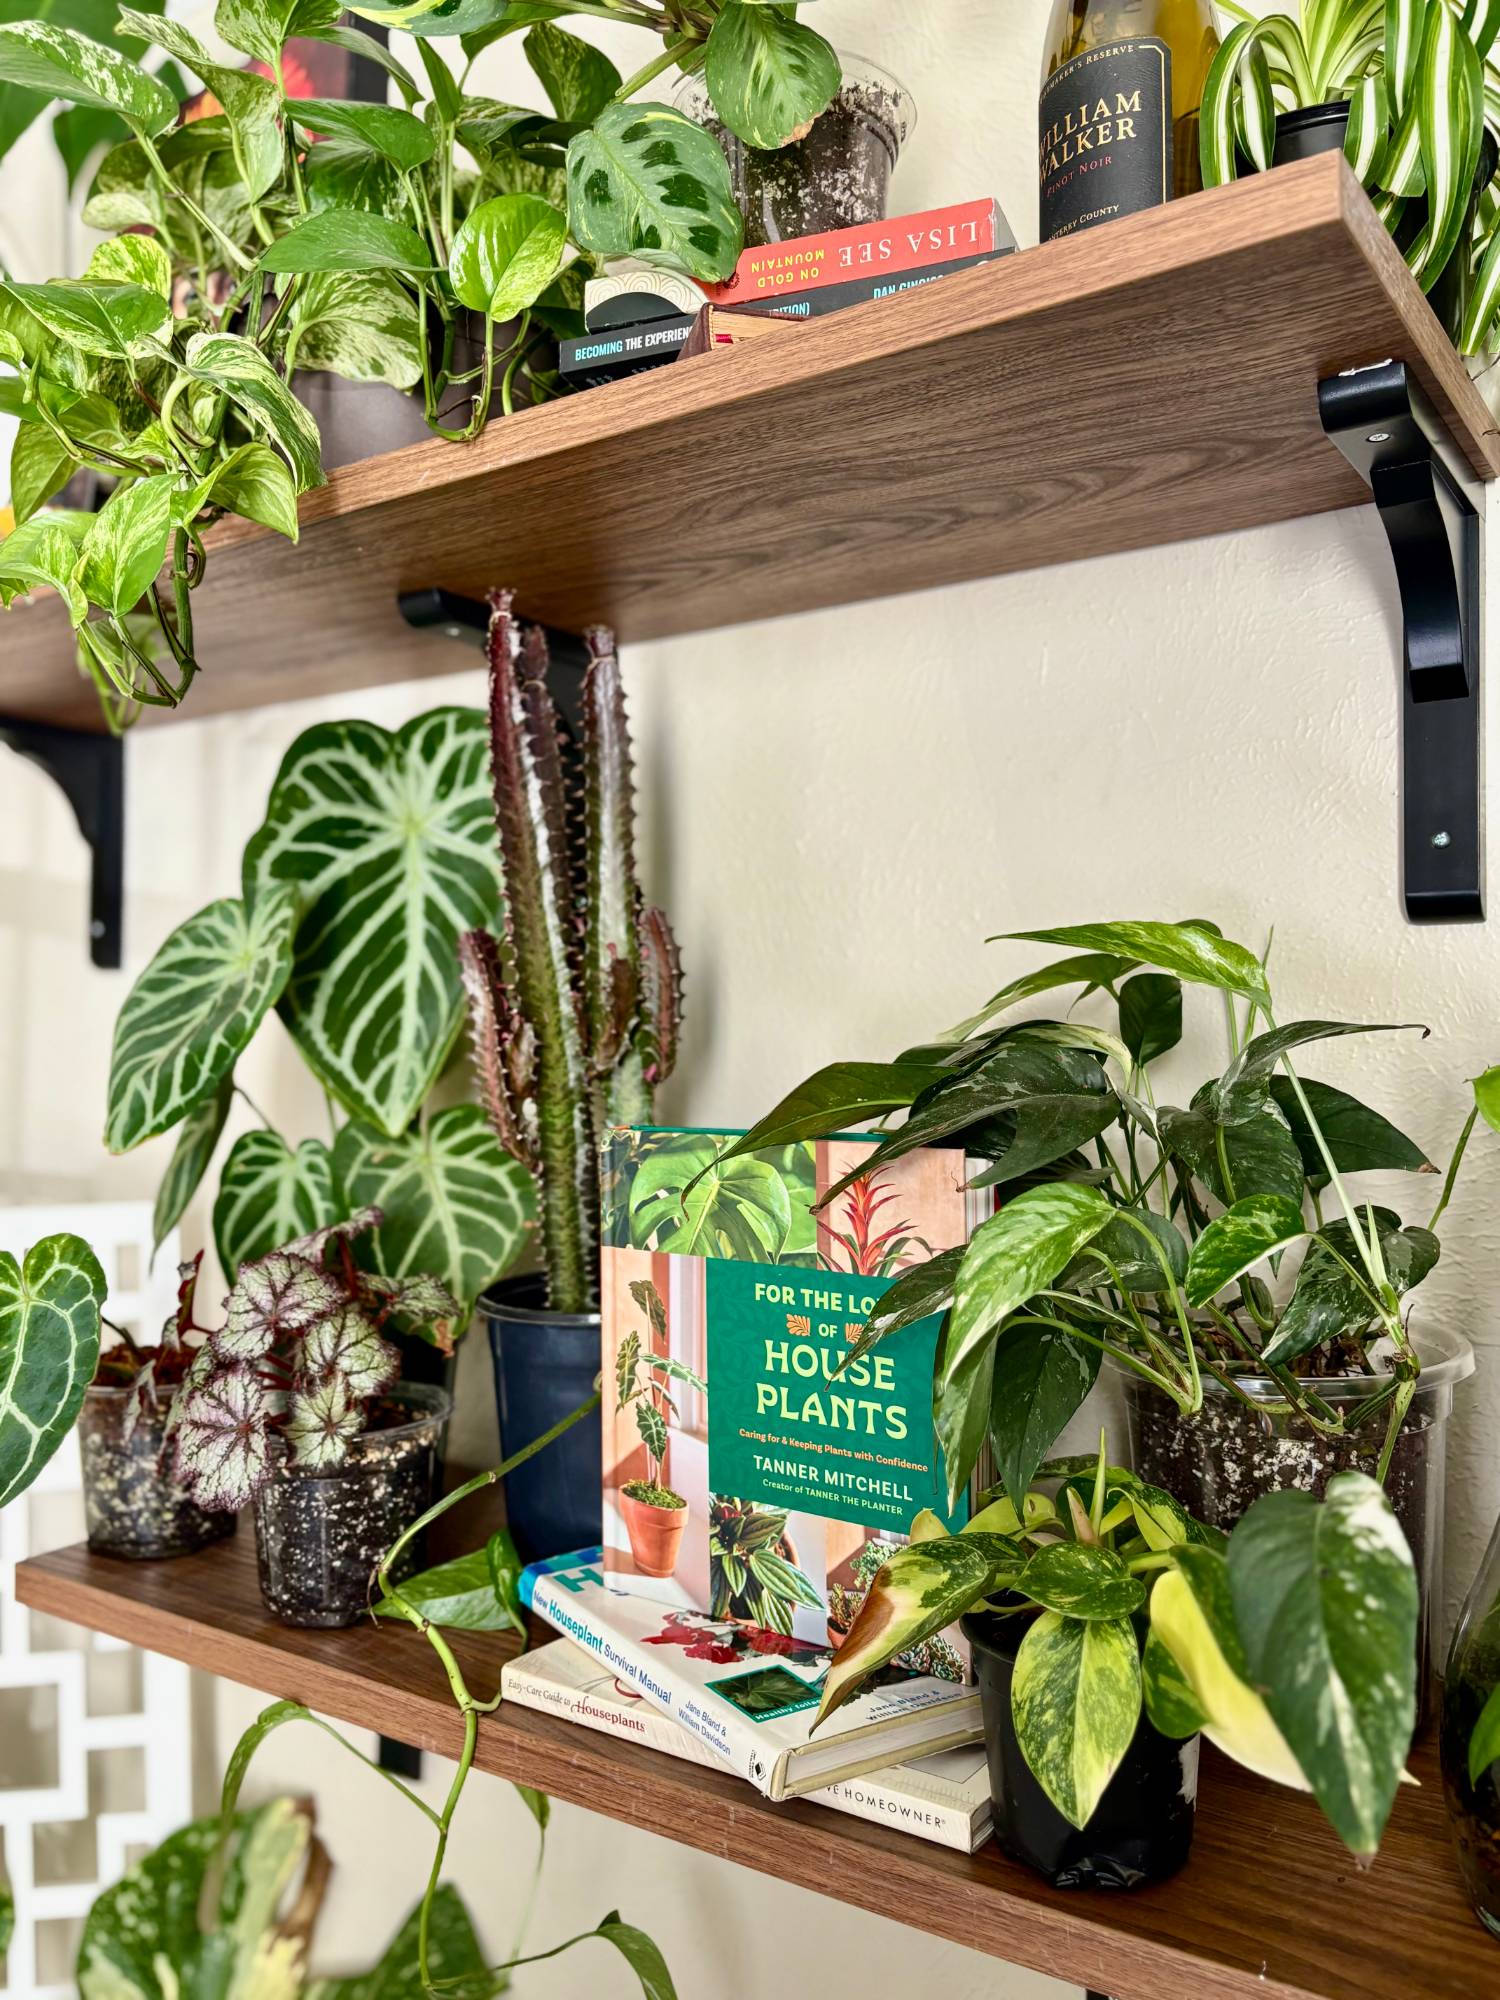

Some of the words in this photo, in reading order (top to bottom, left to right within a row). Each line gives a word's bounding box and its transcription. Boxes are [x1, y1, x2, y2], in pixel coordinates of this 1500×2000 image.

[1086, 44, 1134, 65] RESERVE
[1047, 171, 1074, 197] PINOT
[1079, 155, 1112, 175] NOIR
[1079, 204, 1119, 223] COUNTY
[839, 239, 893, 267] SEE
[907, 221, 977, 253] LISA
[752, 249, 825, 273] MOUNTAIN
[800, 267, 820, 280] ON
[757, 272, 794, 288] GOLD
[873, 285, 896, 300] DAN
[575, 341, 623, 361] BECOMING
[625, 336, 643, 351] THE
[754, 1282, 796, 1306] FOR
[800, 1288, 842, 1312] THE
[848, 1294, 879, 1316] LO
[818, 1323, 838, 1338] OF
[764, 1339, 896, 1391] HOUSE
[755, 1382, 908, 1440] PLANTS
[739, 1428, 766, 1443] Caring
[767, 1433, 780, 1443] for
[781, 1436, 788, 1445] &
[789, 1437, 823, 1453] Keeping
[824, 1444, 852, 1457] Plants
[854, 1450, 874, 1462] with
[875, 1454, 929, 1472] Confidence
[753, 1454, 820, 1482] TANNER
[824, 1469, 913, 1501] MITCHELL
[762, 1478, 793, 1493] Creator
[794, 1486, 804, 1494] of
[805, 1487, 839, 1502] TANNER
[842, 1494, 859, 1506] THE
[861, 1500, 903, 1516] PLANTER
[534, 1589, 548, 1608] New
[549, 1599, 603, 1654] Houseplant
[604, 1644, 638, 1678] Survival
[638, 1670, 672, 1704] Manual
[543, 1690, 563, 1706] Guide
[563, 1698, 571, 1706] to
[571, 1696, 646, 1732] Houseplants
[685, 1700, 701, 1717] Jane
[701, 1711, 721, 1732] Bland
[721, 1726, 727, 1737] &
[866, 1708, 909, 1721] William
[910, 1693, 961, 1708] Davidson
[869, 1703, 896, 1713] Jane
[897, 1693, 930, 1704] Bland
[678, 1707, 700, 1732] William
[701, 1726, 731, 1755] Davidson
